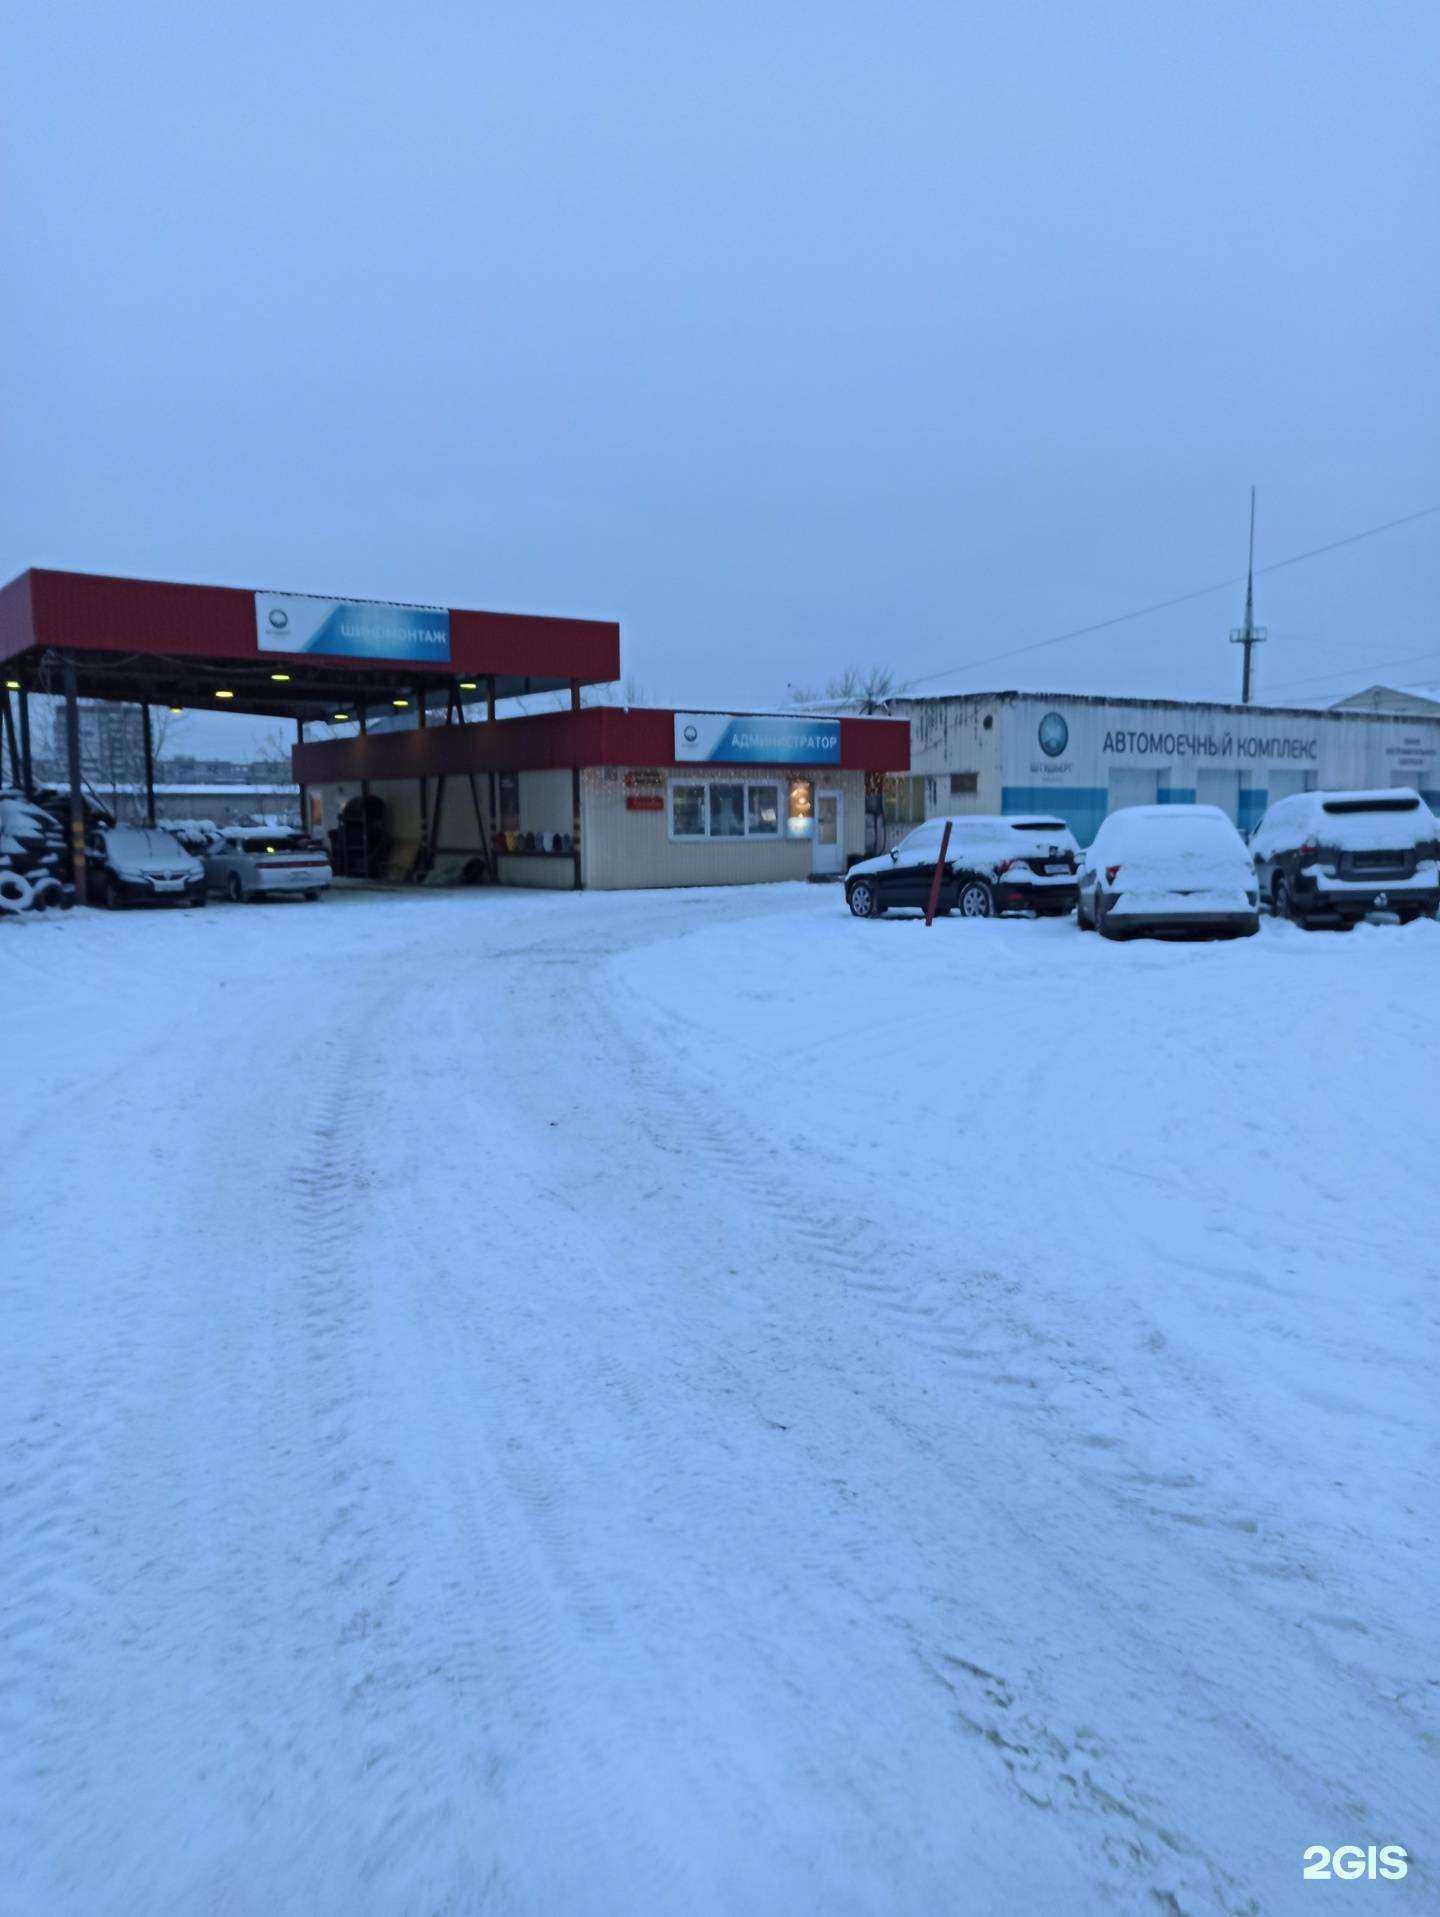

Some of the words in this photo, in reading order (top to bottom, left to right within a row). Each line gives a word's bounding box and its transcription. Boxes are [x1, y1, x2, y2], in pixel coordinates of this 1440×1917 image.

[731, 733, 838, 750] АДМИНИСТРАТОР
[1103, 732, 1233, 758] АВТОМОЕЧНЫЙ
[1238, 738, 1318, 760] КОМПЛЕКС
